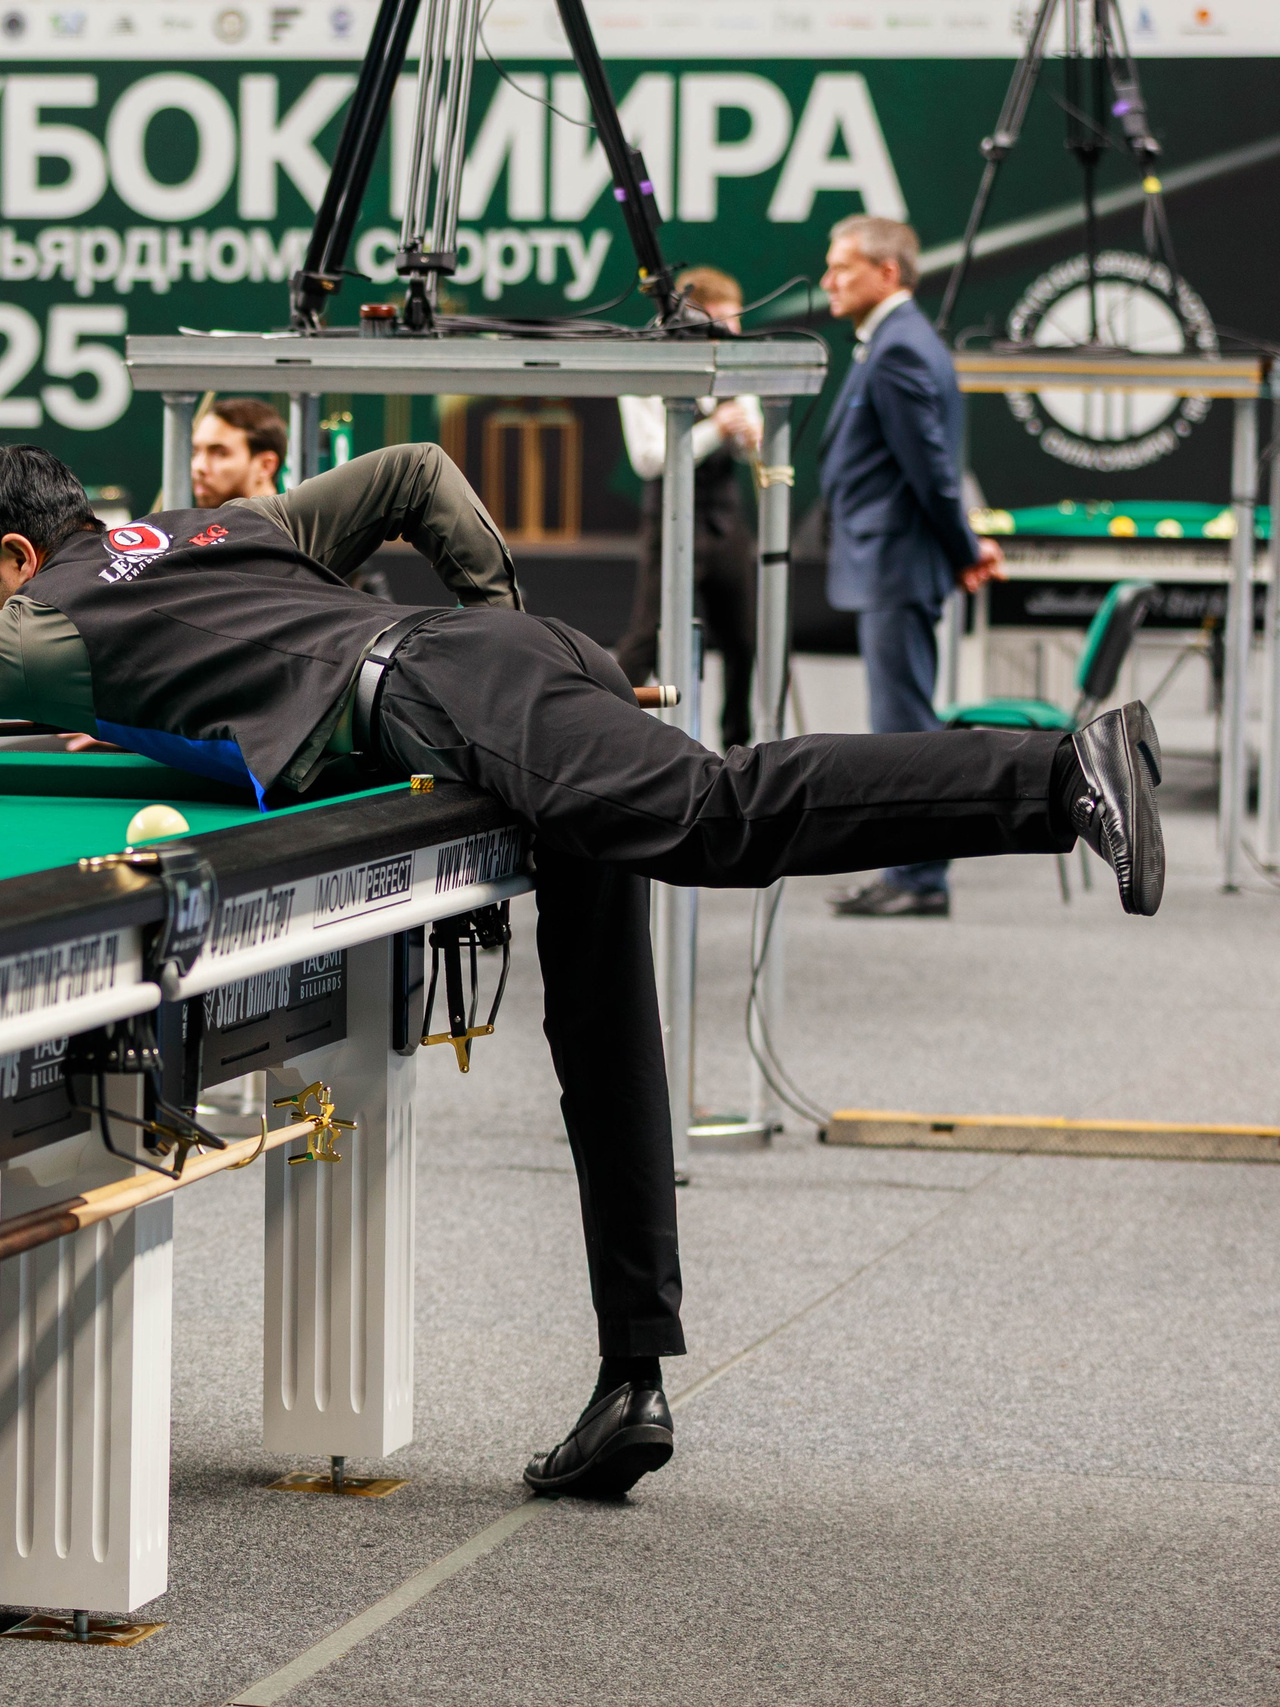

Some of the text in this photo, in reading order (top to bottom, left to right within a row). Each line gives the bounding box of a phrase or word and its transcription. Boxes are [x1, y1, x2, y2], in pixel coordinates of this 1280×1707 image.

[389, 69, 908, 224] МИРА
[355, 226, 613, 302] сорту
[300, 975, 342, 999] BILLIARDS
[30, 1065, 65, 1089] BILLI
